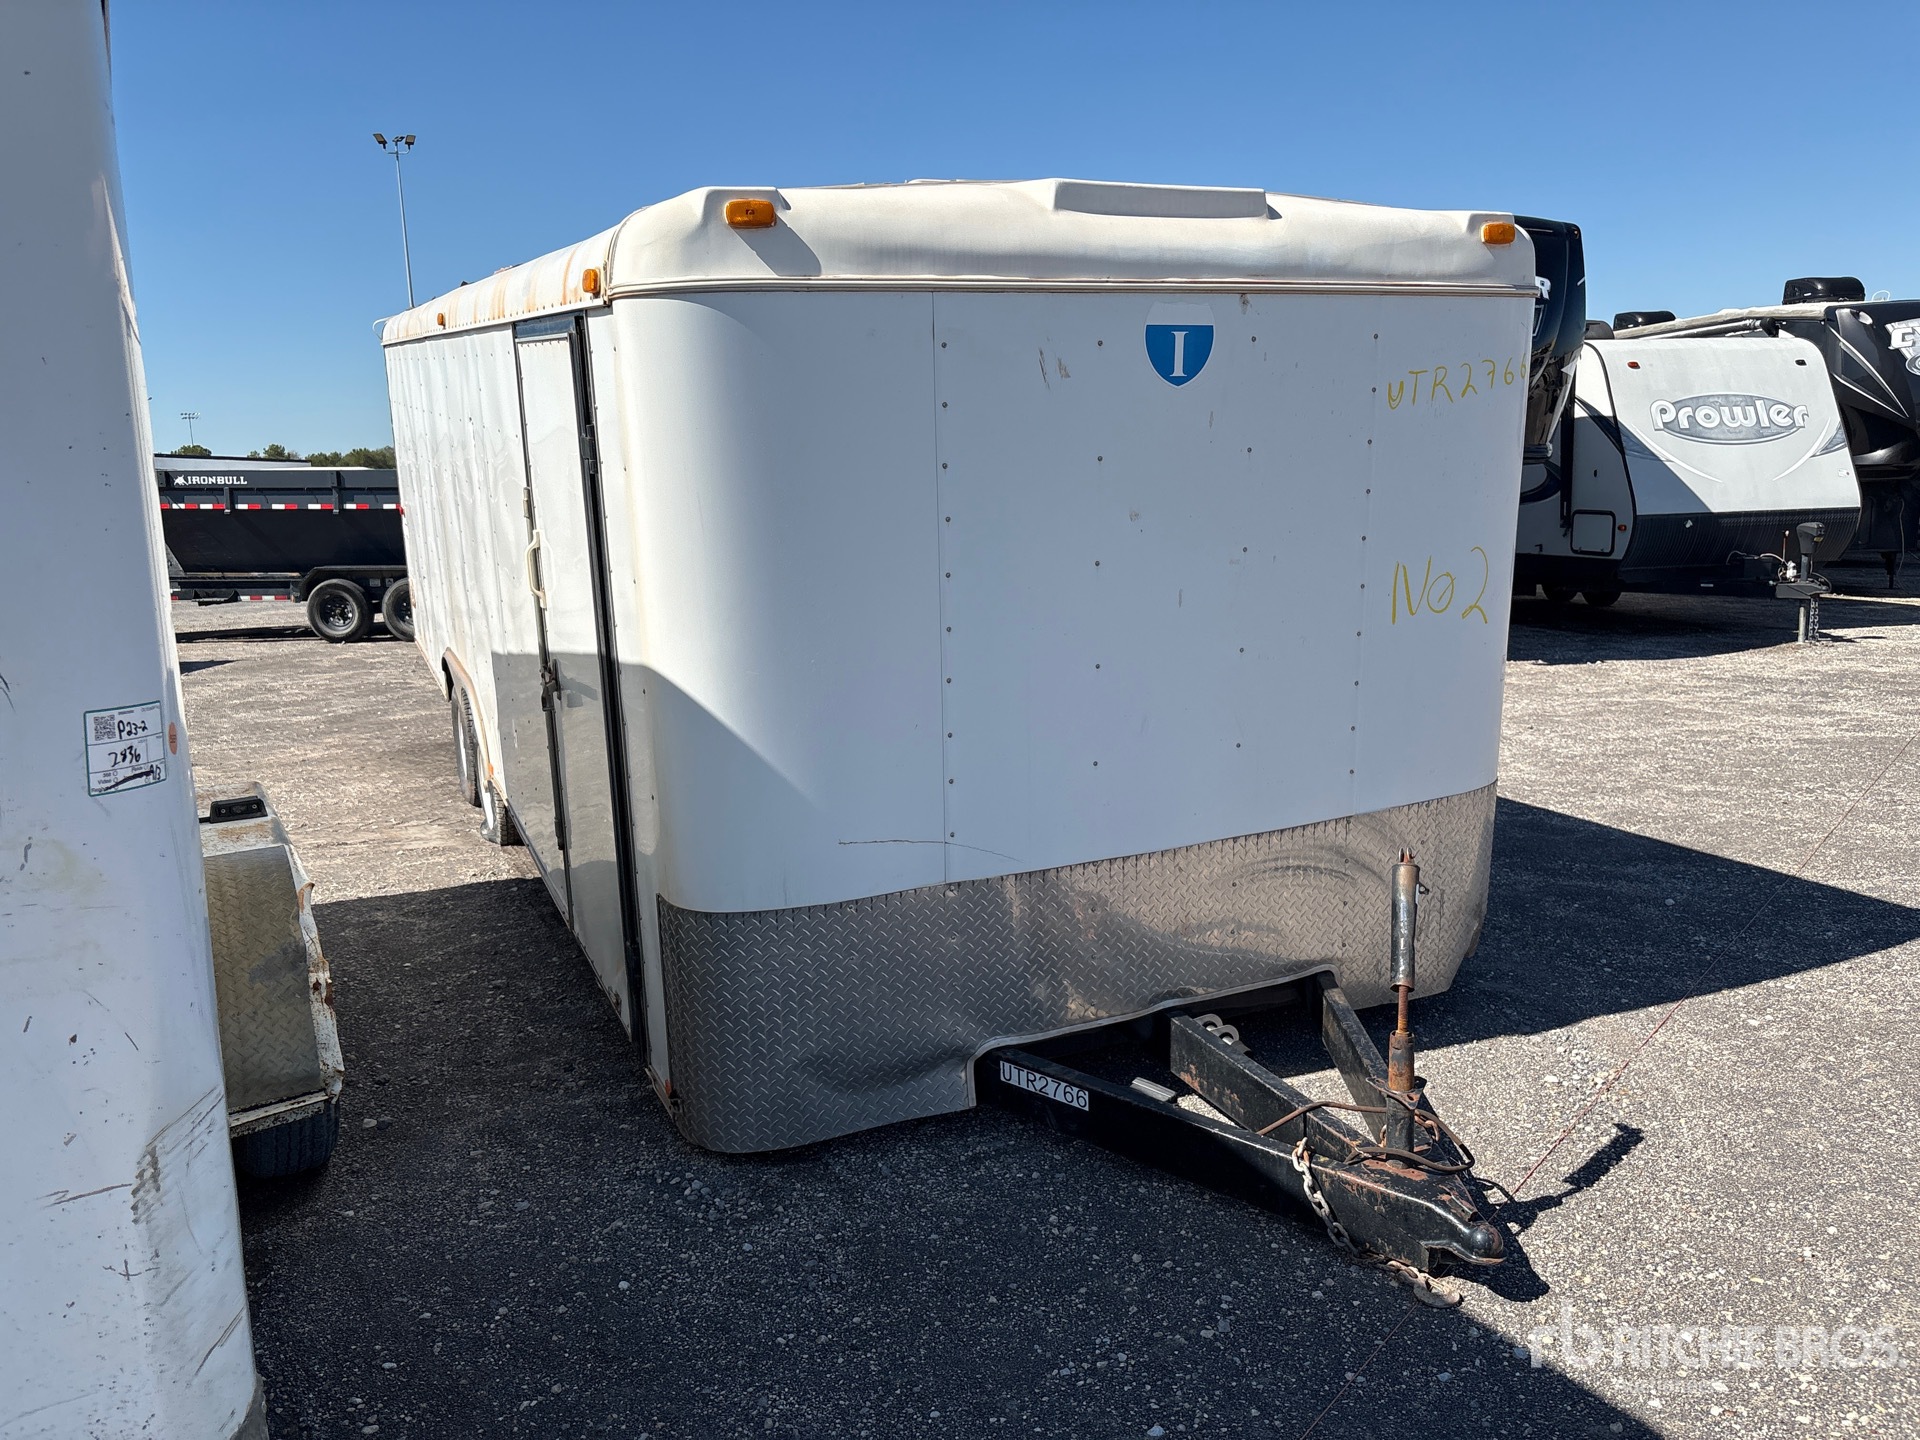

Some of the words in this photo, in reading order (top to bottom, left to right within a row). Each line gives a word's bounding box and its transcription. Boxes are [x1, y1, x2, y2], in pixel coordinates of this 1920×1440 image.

[1388, 354, 1527, 410] UTR2766
[1650, 400, 1809, 431] Prowler
[187, 475, 248, 485] IRONBULL
[117, 720, 148, 739] P23-2
[108, 745, 141, 767] 2836
[1002, 1062, 1087, 1108] UTR2766
